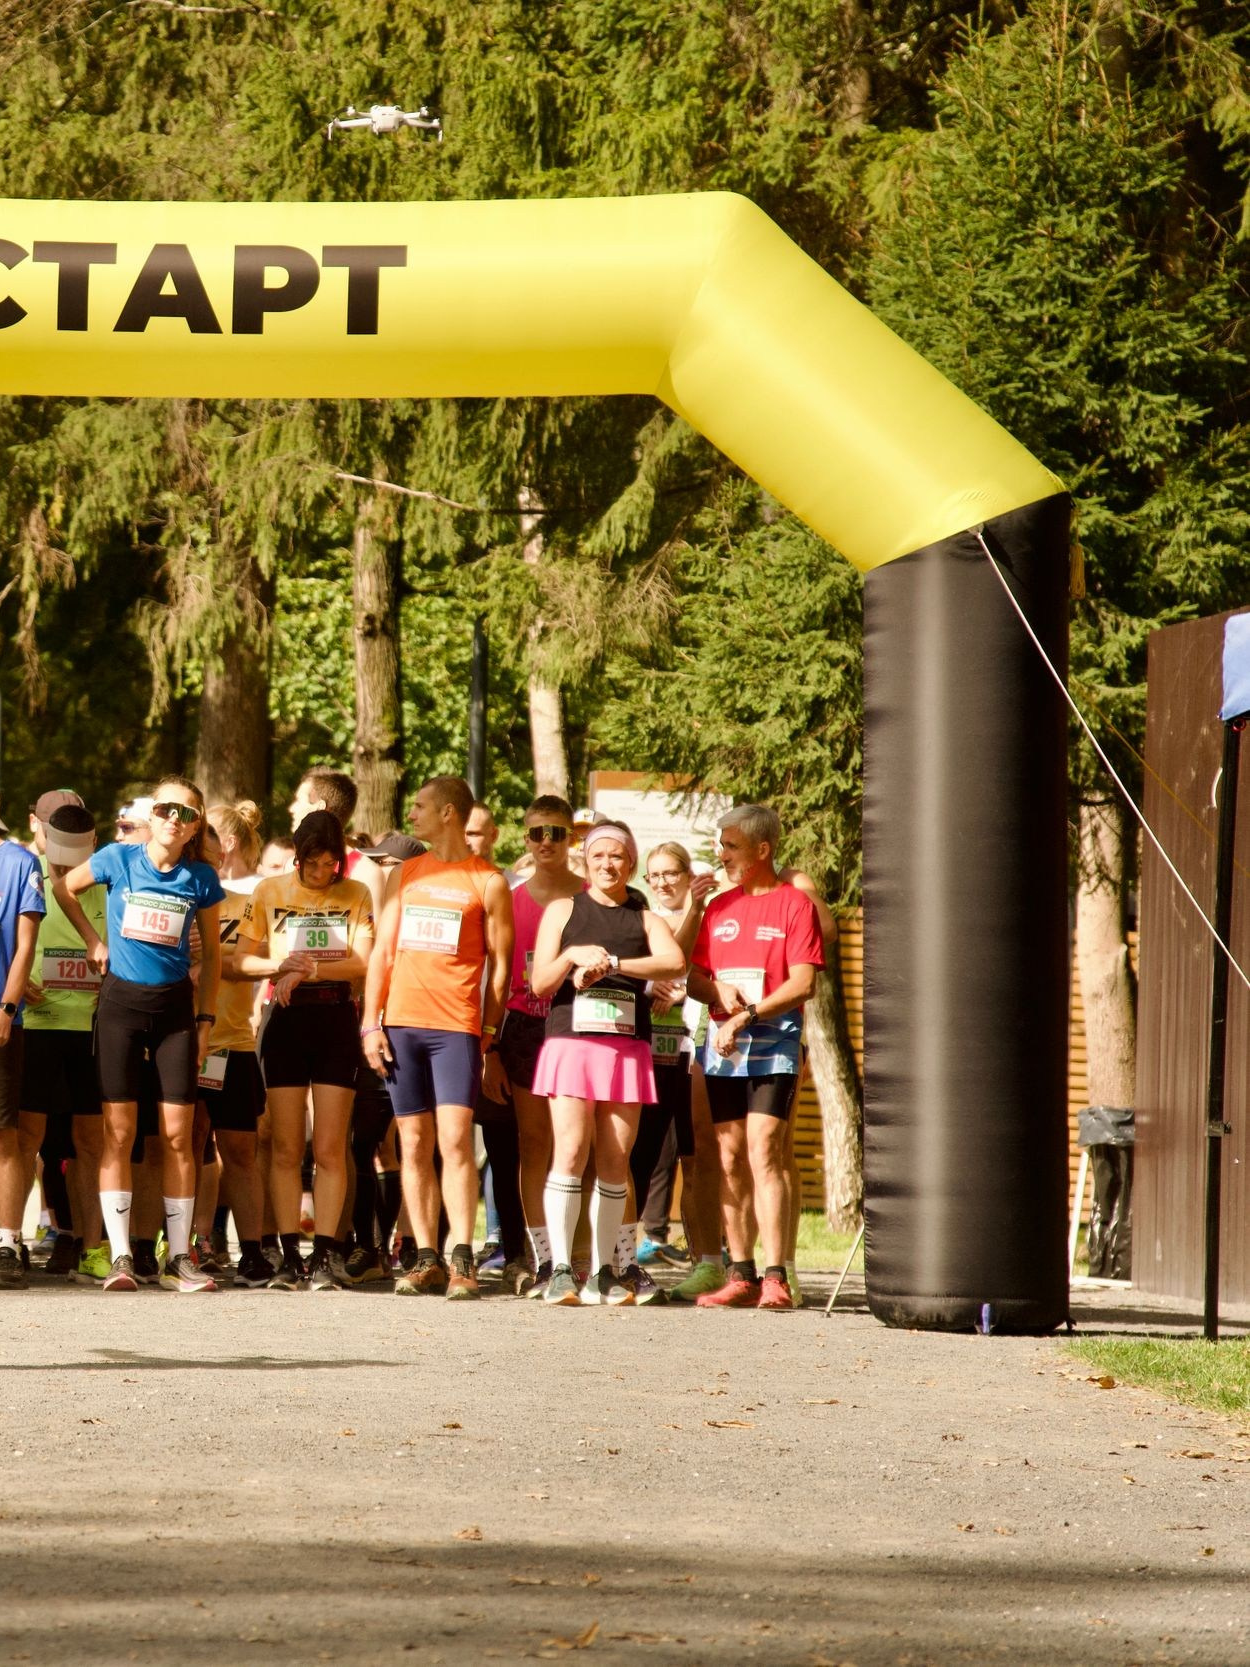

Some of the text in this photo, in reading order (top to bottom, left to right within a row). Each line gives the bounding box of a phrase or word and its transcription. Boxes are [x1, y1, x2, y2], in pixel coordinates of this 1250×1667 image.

[134, 898, 182, 912] КРОСС ДУБКИ
[141, 911, 170, 932] 145
[416, 921, 444, 939] 146
[306, 930, 328, 947] 39
[57, 961, 87, 979] 120
[582, 990, 630, 1000] КРОСС ДУБКИ
[594, 1002, 617, 1020] 50
[656, 1036, 677, 1054] 30
